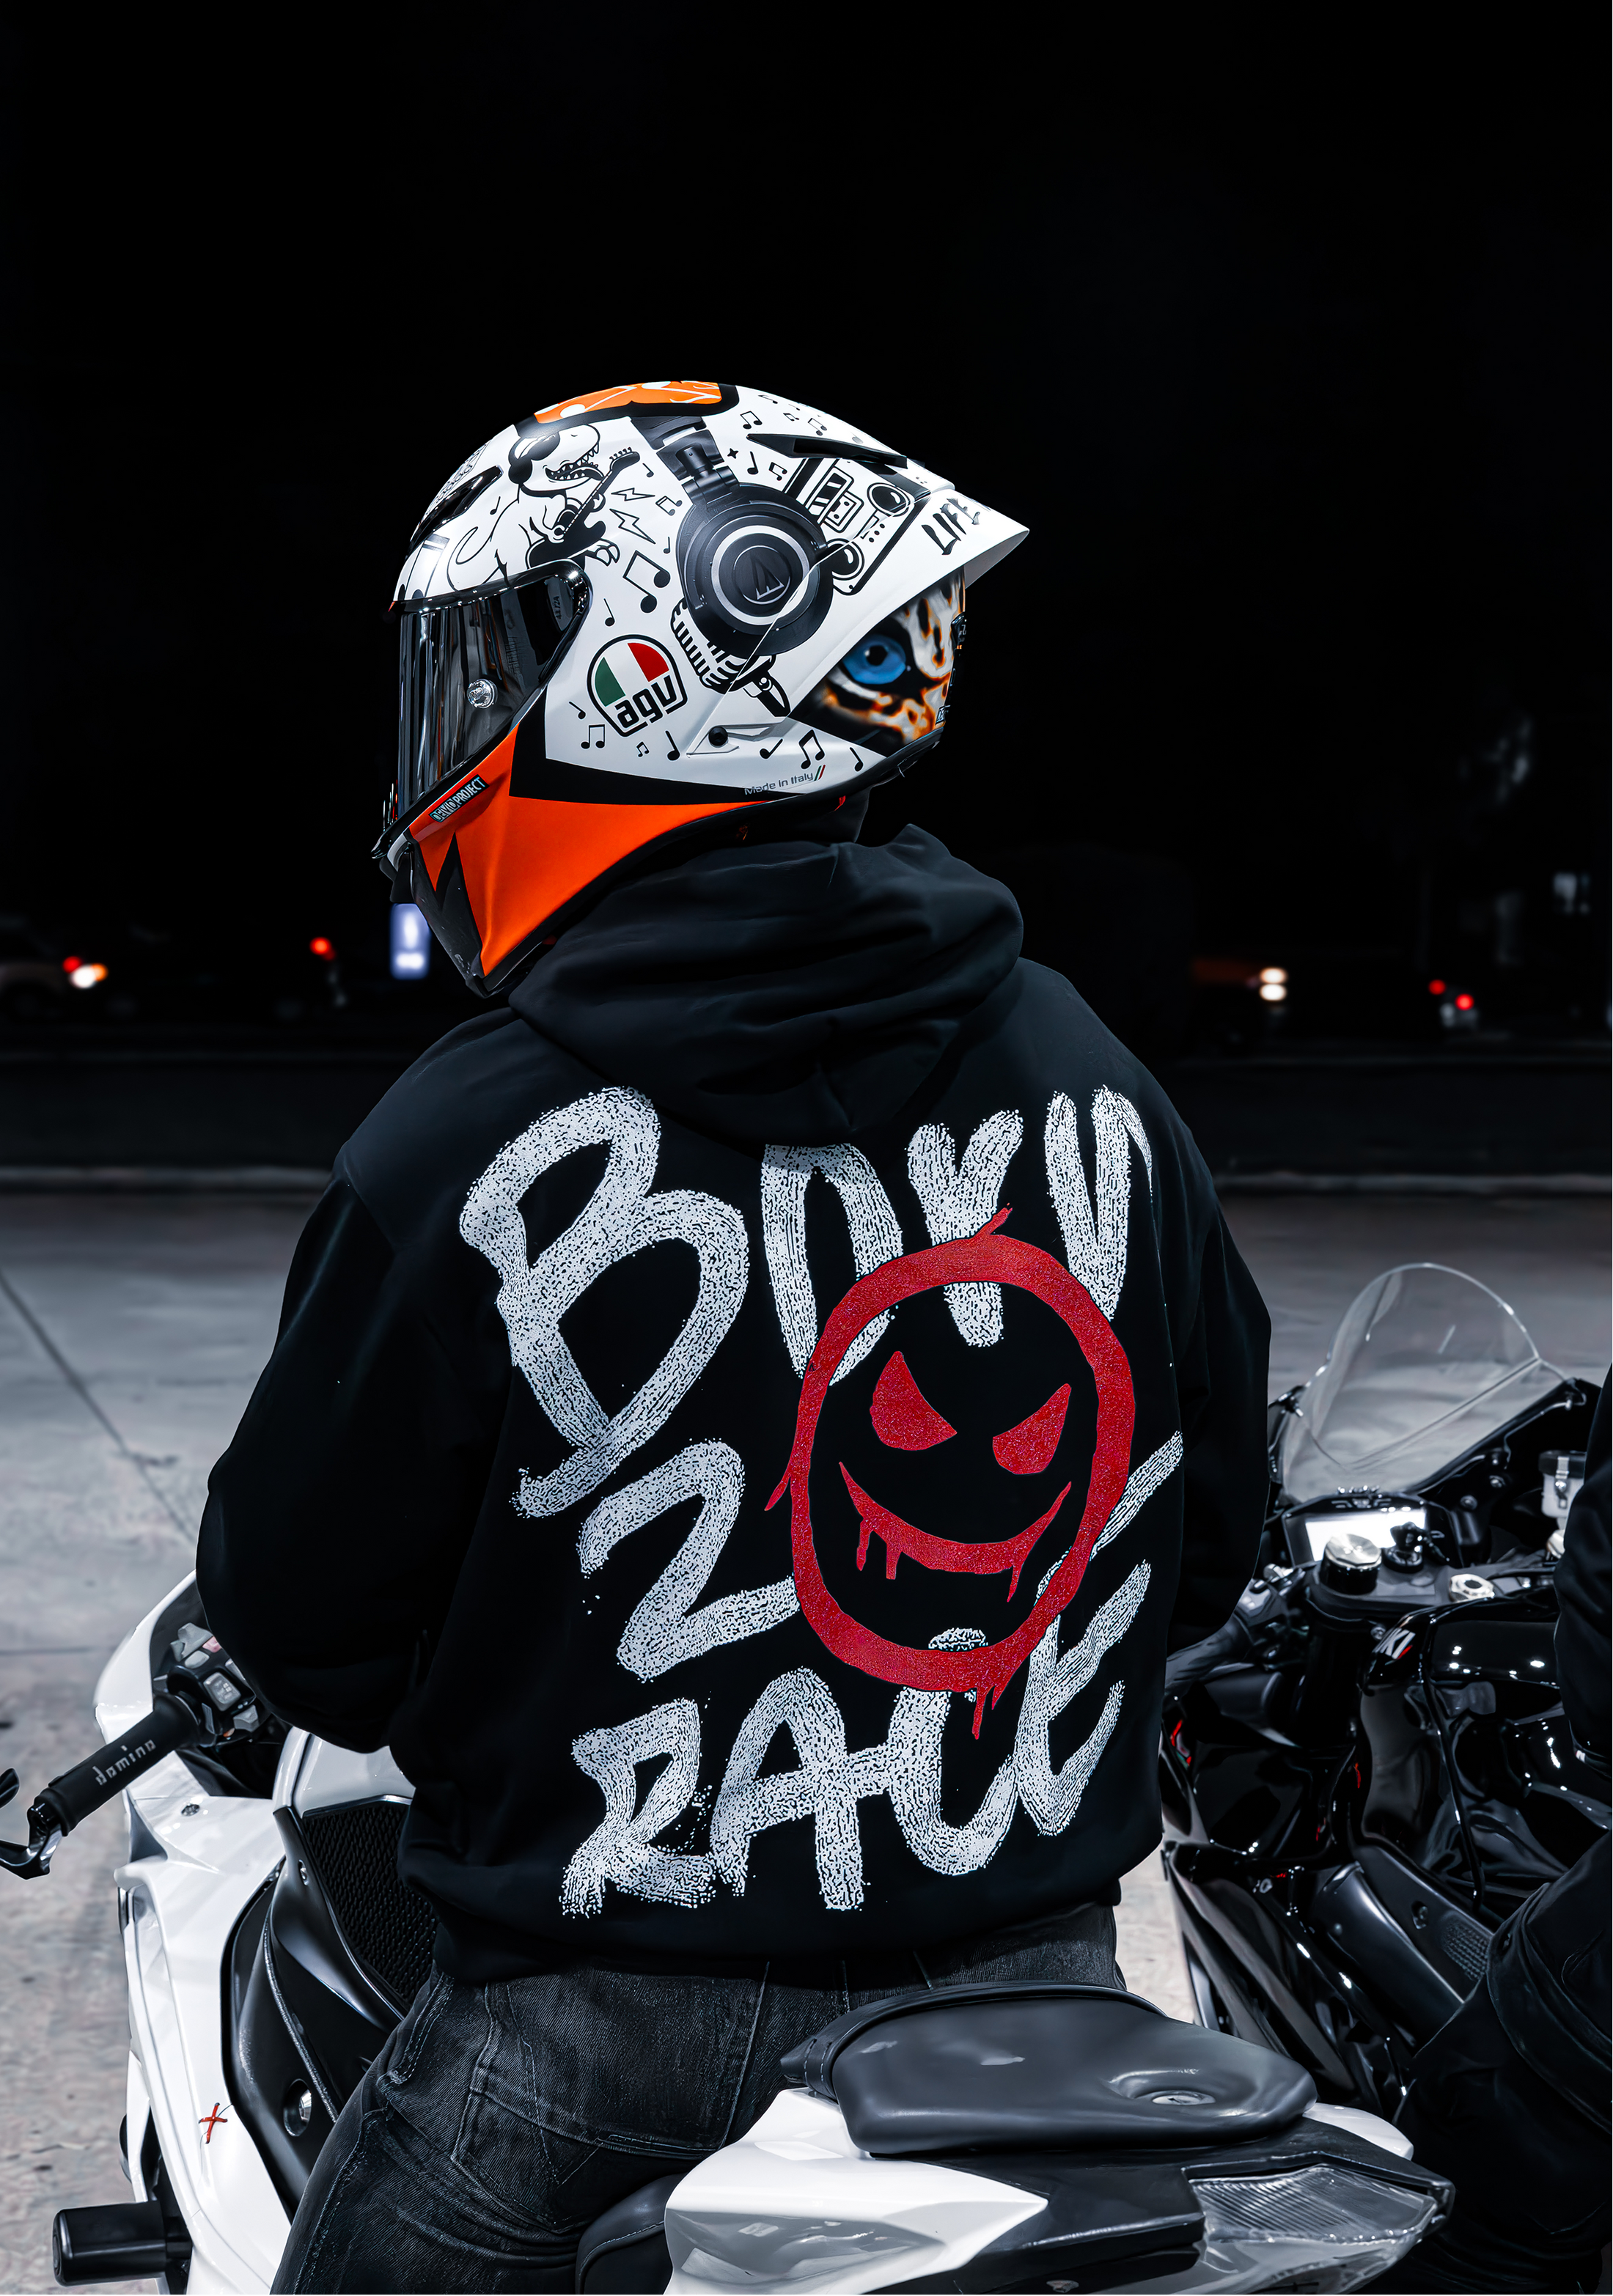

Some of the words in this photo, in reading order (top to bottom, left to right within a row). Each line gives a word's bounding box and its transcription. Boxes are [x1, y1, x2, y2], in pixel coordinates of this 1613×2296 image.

[921, 498, 980, 555] LIFE
[614, 674, 677, 728] agv
[452, 776, 486, 805] PROJECT
[744, 781, 776, 795] Made
[778, 779, 788, 788] in
[790, 772, 814, 784] Italy
[559, 1430, 1183, 1918] RACE
[92, 1740, 156, 1785] domino
